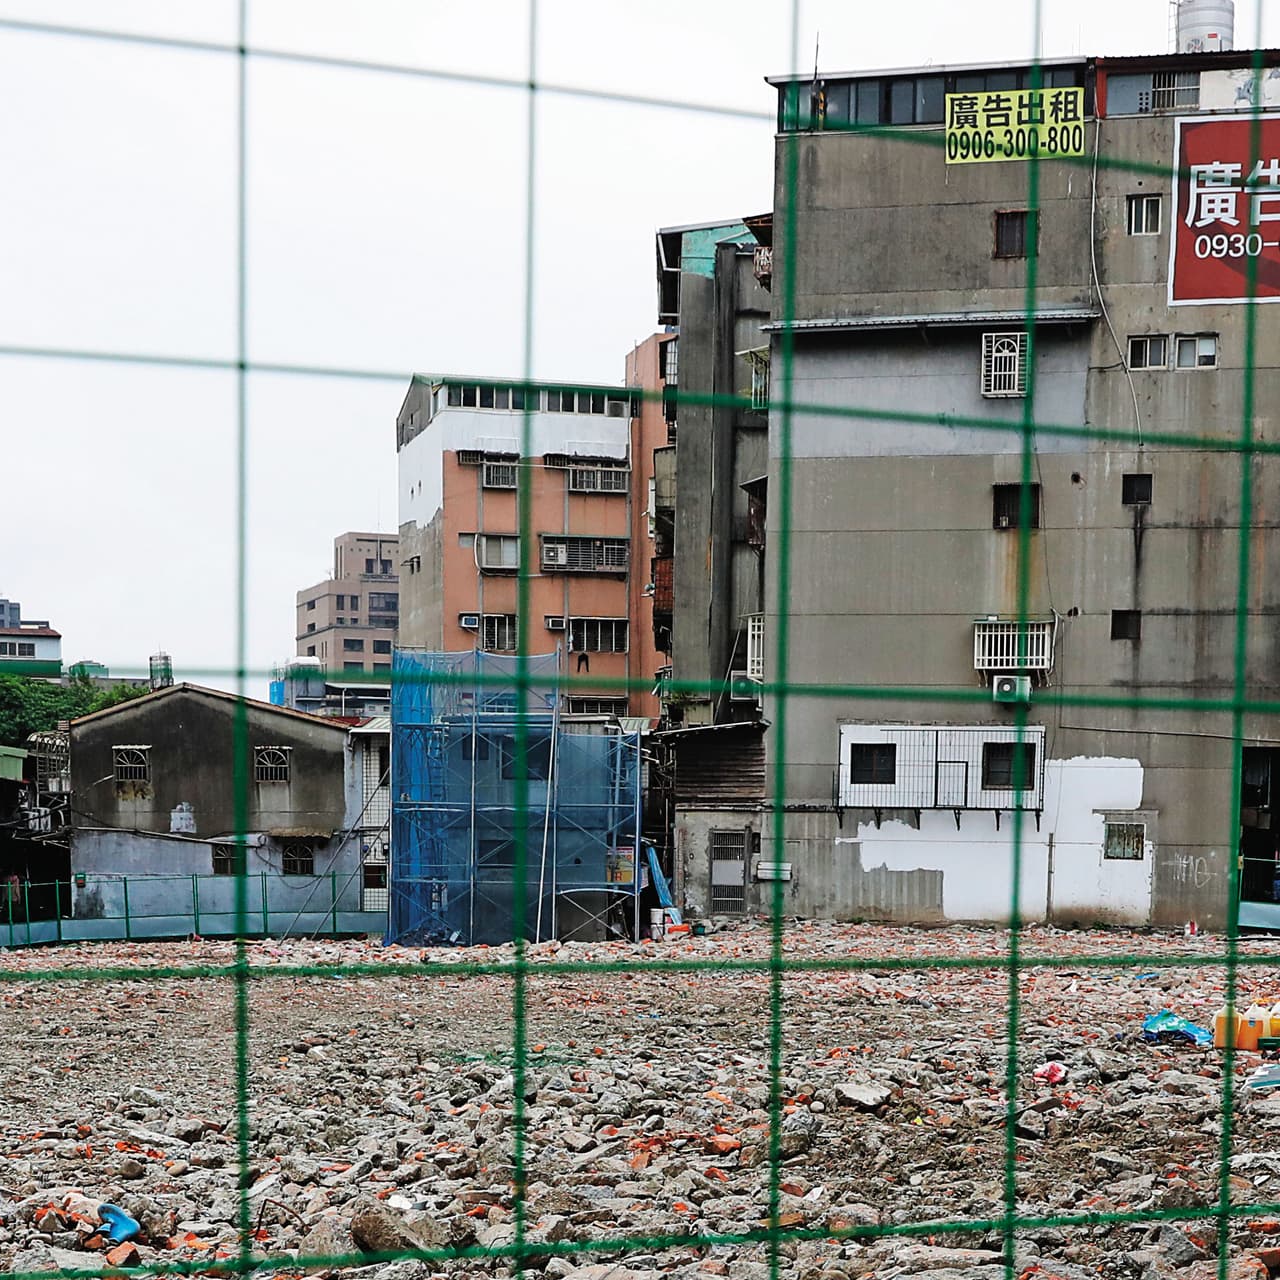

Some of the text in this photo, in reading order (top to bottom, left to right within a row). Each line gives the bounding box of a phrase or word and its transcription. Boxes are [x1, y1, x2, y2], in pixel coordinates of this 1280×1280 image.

[948, 90, 1081, 130] 廣告出租
[947, 125, 1083, 160] 0906-300-800
